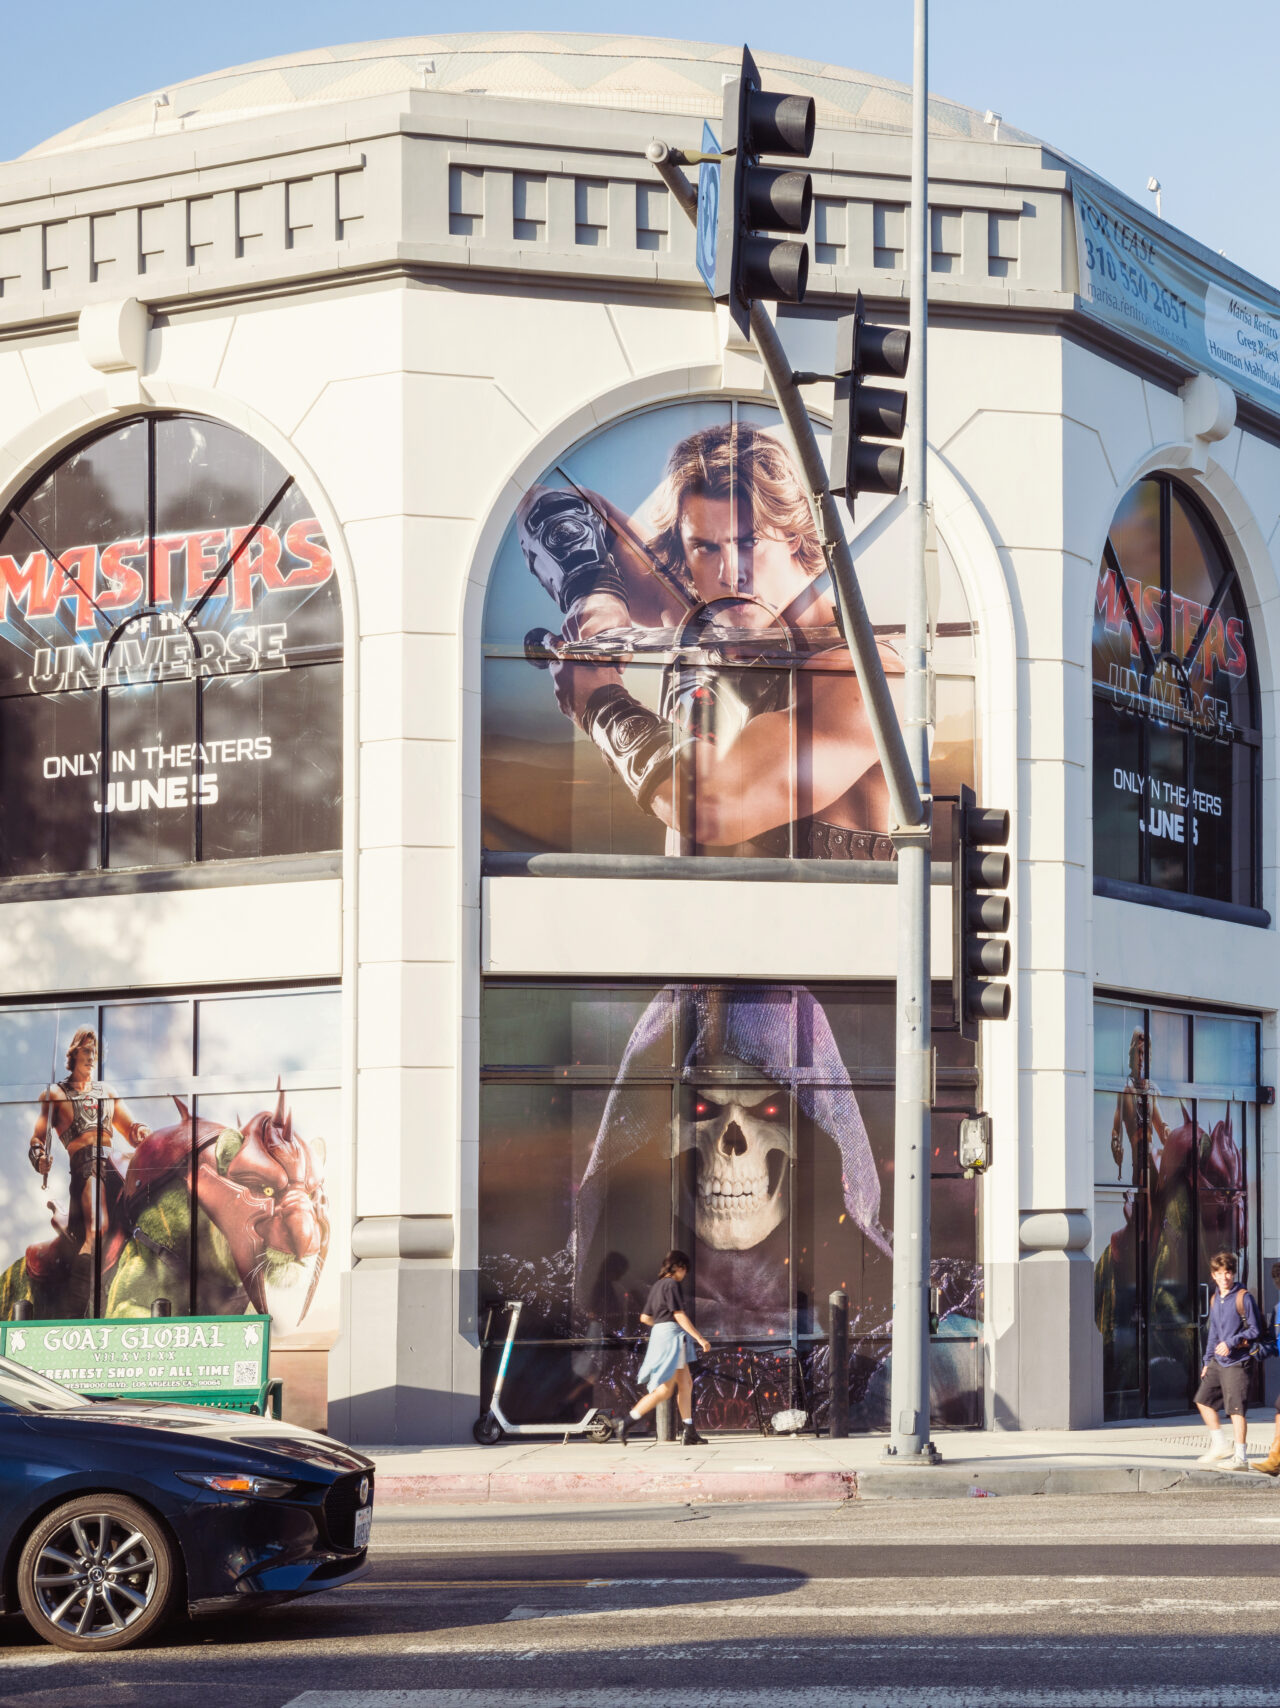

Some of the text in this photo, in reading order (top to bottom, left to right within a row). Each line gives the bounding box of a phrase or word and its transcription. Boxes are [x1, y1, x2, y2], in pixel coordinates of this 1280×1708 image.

[1113, 220, 1156, 266] LEASE
[1084, 237, 1117, 282] 310
[1119, 260, 1148, 302] 550
[1228, 298, 1279, 340] Marisa Renfro
[1208, 339, 1243, 370] Houman
[1236, 329, 1257, 357] Greg
[0, 518, 335, 631] MASTERS
[1096, 567, 1247, 684] MASTERS
[29, 623, 290, 695] UNIVERSE
[43, 736, 272, 779] ONLY IN THEATERS
[94, 773, 219, 813] JUNE 5
[1113, 767, 1145, 795] ONLY
[43, 1324, 227, 1351] GOAT GLOBAL
[107, 1366, 144, 1379] SHOP
[148, 1366, 165, 1377] OF
[168, 1365, 193, 1377] ALL
[197, 1364, 231, 1376] TIME
[132, 1380, 147, 1388] LOS
[148, 1379, 181, 1388] ANGELES
